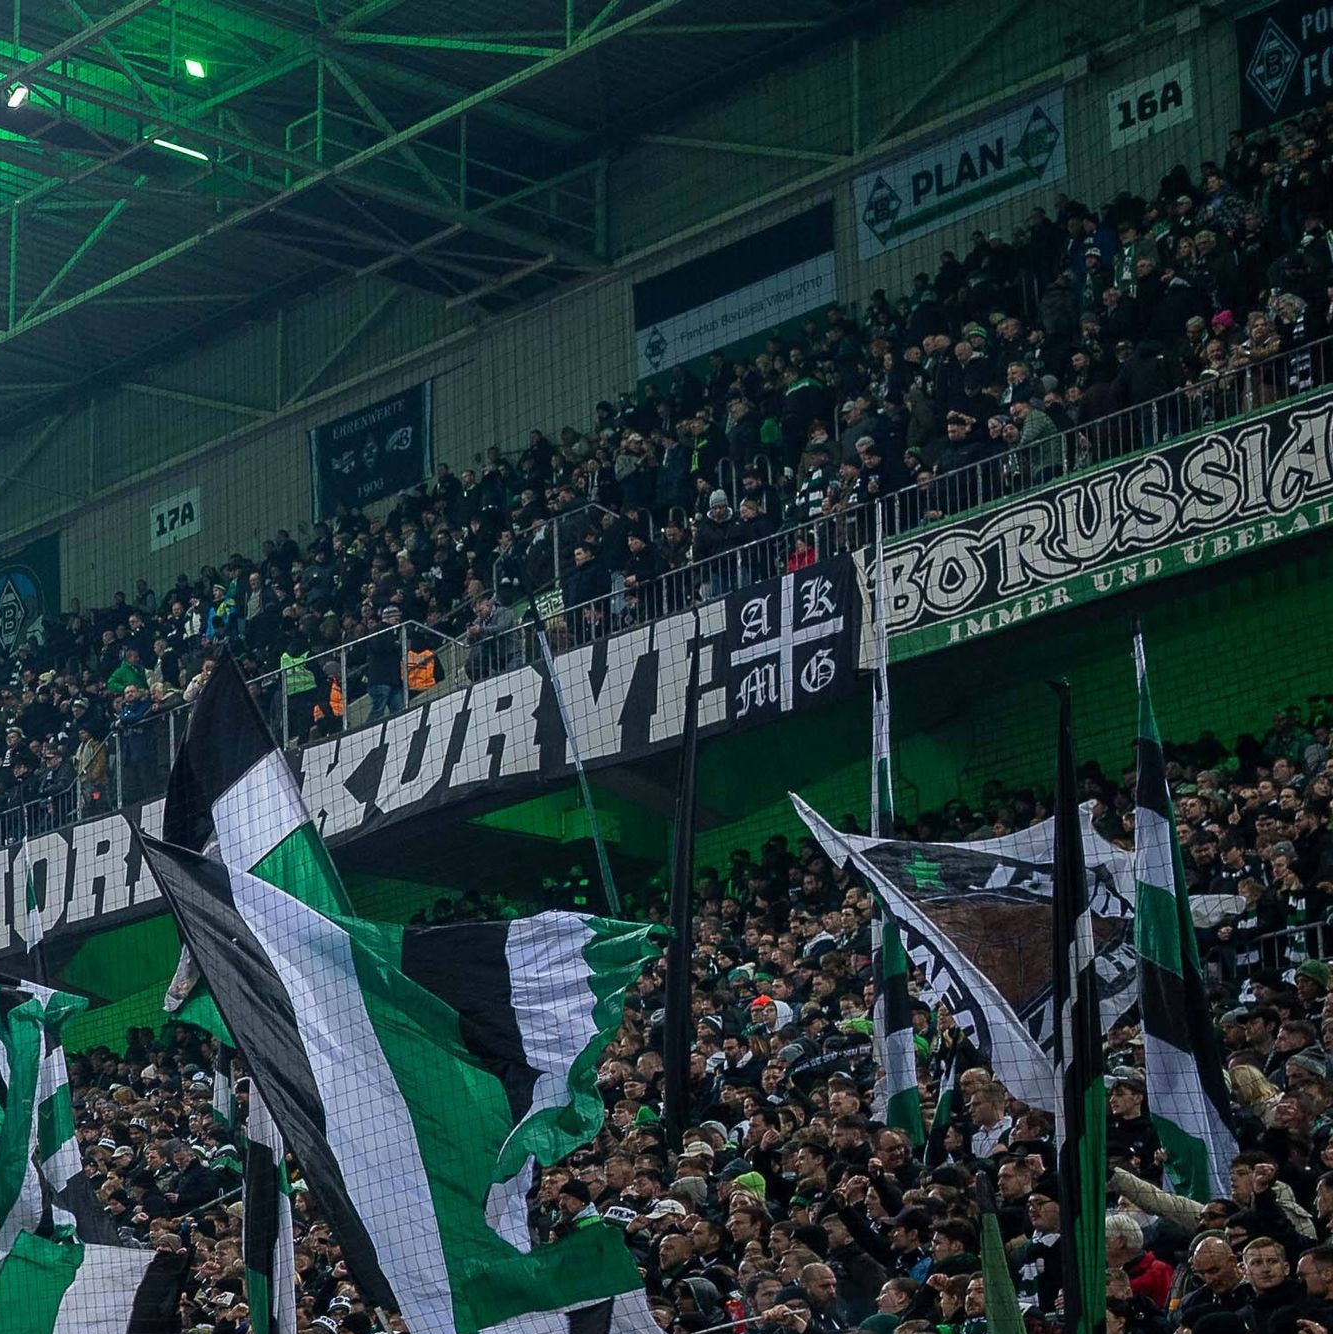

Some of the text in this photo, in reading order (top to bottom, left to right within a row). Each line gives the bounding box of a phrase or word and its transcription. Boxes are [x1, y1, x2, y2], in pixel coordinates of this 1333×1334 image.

[1118, 81, 1183, 131] 16A
[912, 137, 1005, 206] PLAN
[155, 501, 195, 537] 17A
[867, 398, 1333, 634] BORUSSIA
[947, 588, 1073, 644] IMMER
[1094, 558, 1164, 593] UND
[301, 601, 726, 838] KURVE
